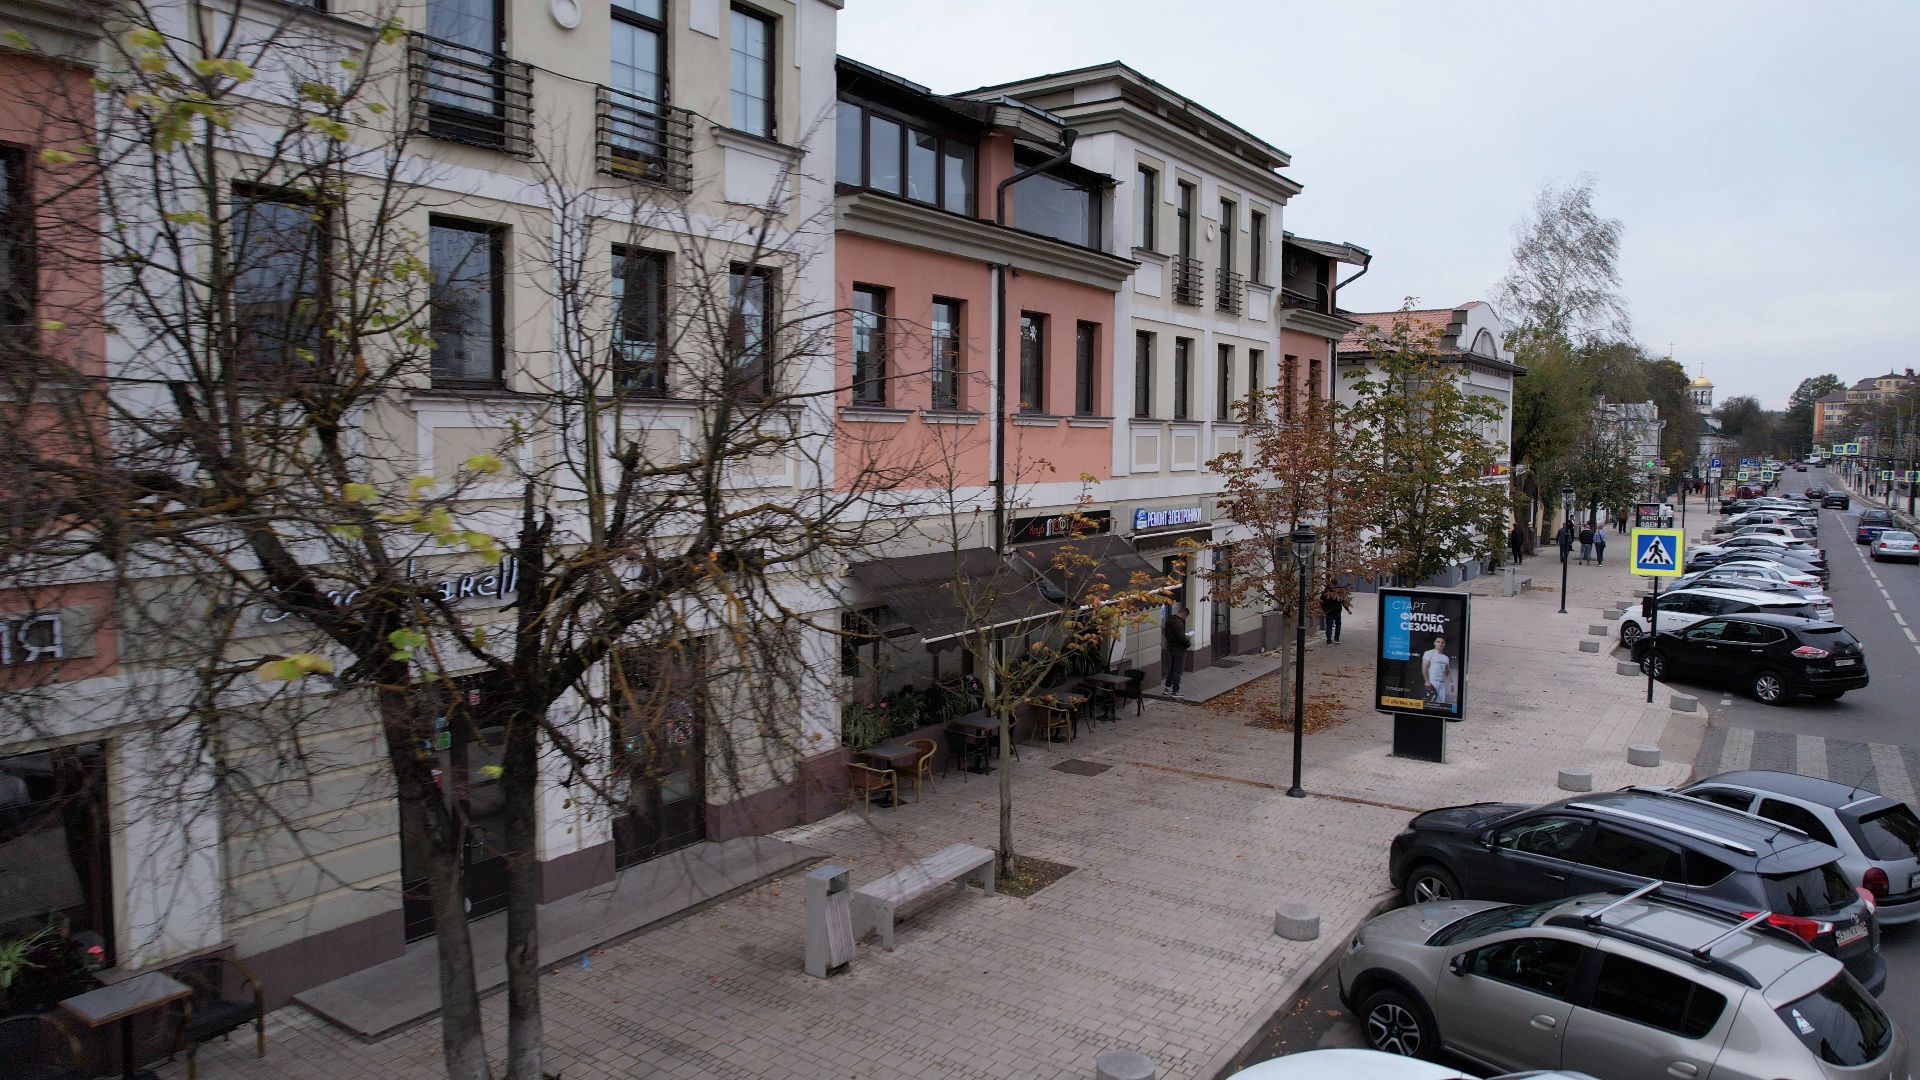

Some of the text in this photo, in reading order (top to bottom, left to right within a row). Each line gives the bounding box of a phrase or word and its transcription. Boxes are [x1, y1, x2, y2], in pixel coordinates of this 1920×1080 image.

[1147, 510, 1167, 527] РЕМОНТ
[1392, 600, 1427, 611] СТАРТ
[1400, 612, 1450, 623] ФИТНЕС-
[1400, 622, 1444, 634] СЕЗОНА
